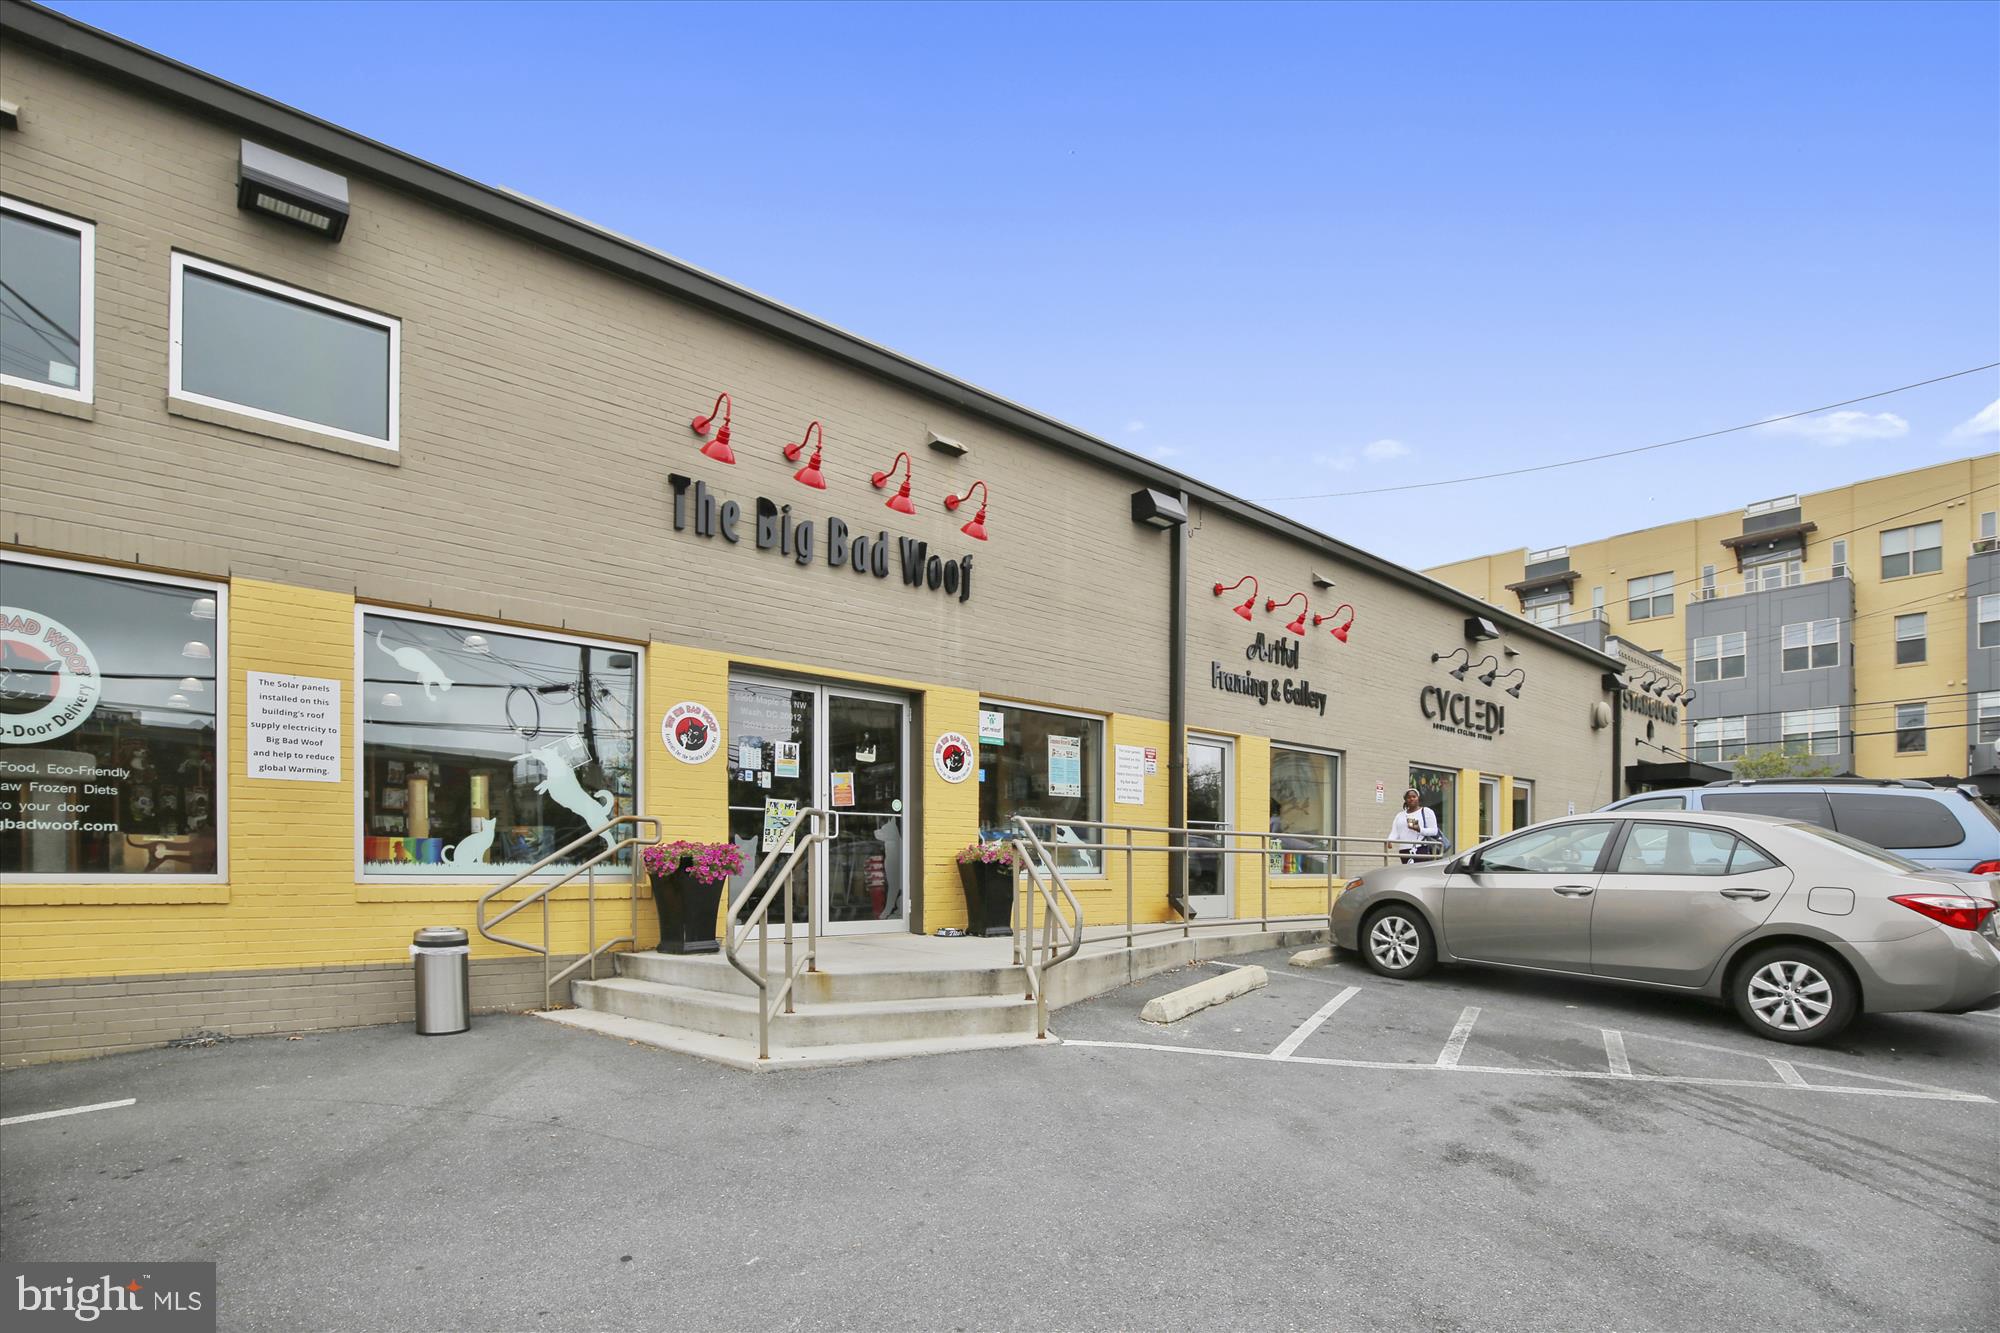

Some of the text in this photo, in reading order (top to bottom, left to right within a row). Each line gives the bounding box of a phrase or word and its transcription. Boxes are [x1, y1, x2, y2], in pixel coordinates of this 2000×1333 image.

[667, 472, 973, 603] The Big Bad Woof
[43, 627, 92, 677] WOOF
[1246, 632, 1299, 669] Artful
[277, 680, 299, 689] Solar
[301, 684, 330, 692] panels
[1211, 660, 1327, 716] Framing & Gallery
[51, 683, 95, 728] Delivery
[259, 693, 297, 703] installed
[313, 698, 330, 706] this
[262, 707, 305, 718] building's
[1420, 685, 1504, 735] CYCLED!
[1623, 689, 1678, 725] STARBUCKS
[250, 721, 280, 731] supply
[282, 723, 326, 735] electricity
[266, 736, 324, 746] Big Bad Woof
[253, 749, 270, 757] and
[272, 750, 292, 759] help
[305, 753, 335, 761] reduce
[47, 764, 130, 780] Eco-Friendly
[258, 764, 330, 776] global Warming.
[29, 782, 77, 793] Frozen
[84, 784, 118, 795] Diets
[19, 802, 51, 813] your
[57, 802, 90, 812] door
